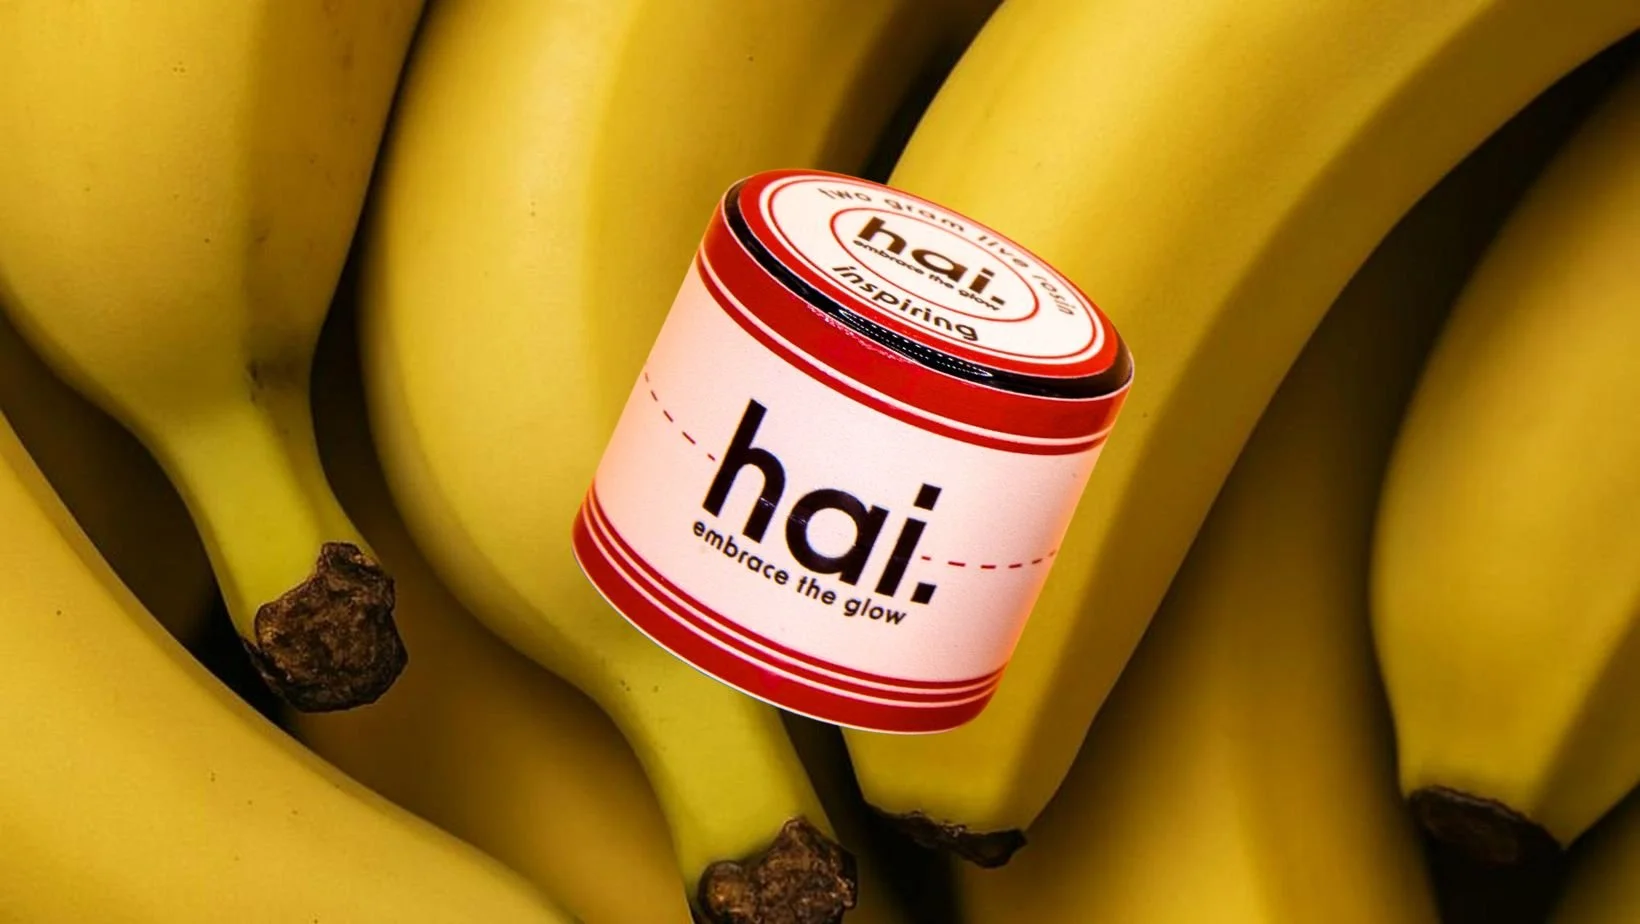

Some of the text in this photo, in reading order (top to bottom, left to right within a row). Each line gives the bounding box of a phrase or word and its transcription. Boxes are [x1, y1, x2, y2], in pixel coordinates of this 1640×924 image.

[818, 187, 1075, 316] two gram live rosin
[853, 239, 1001, 311] embrace the glow
[857, 216, 1006, 306] hai.
[832, 264, 980, 341] inspiring
[702, 397, 942, 605] hai.
[692, 520, 907, 625] embrace the glow
